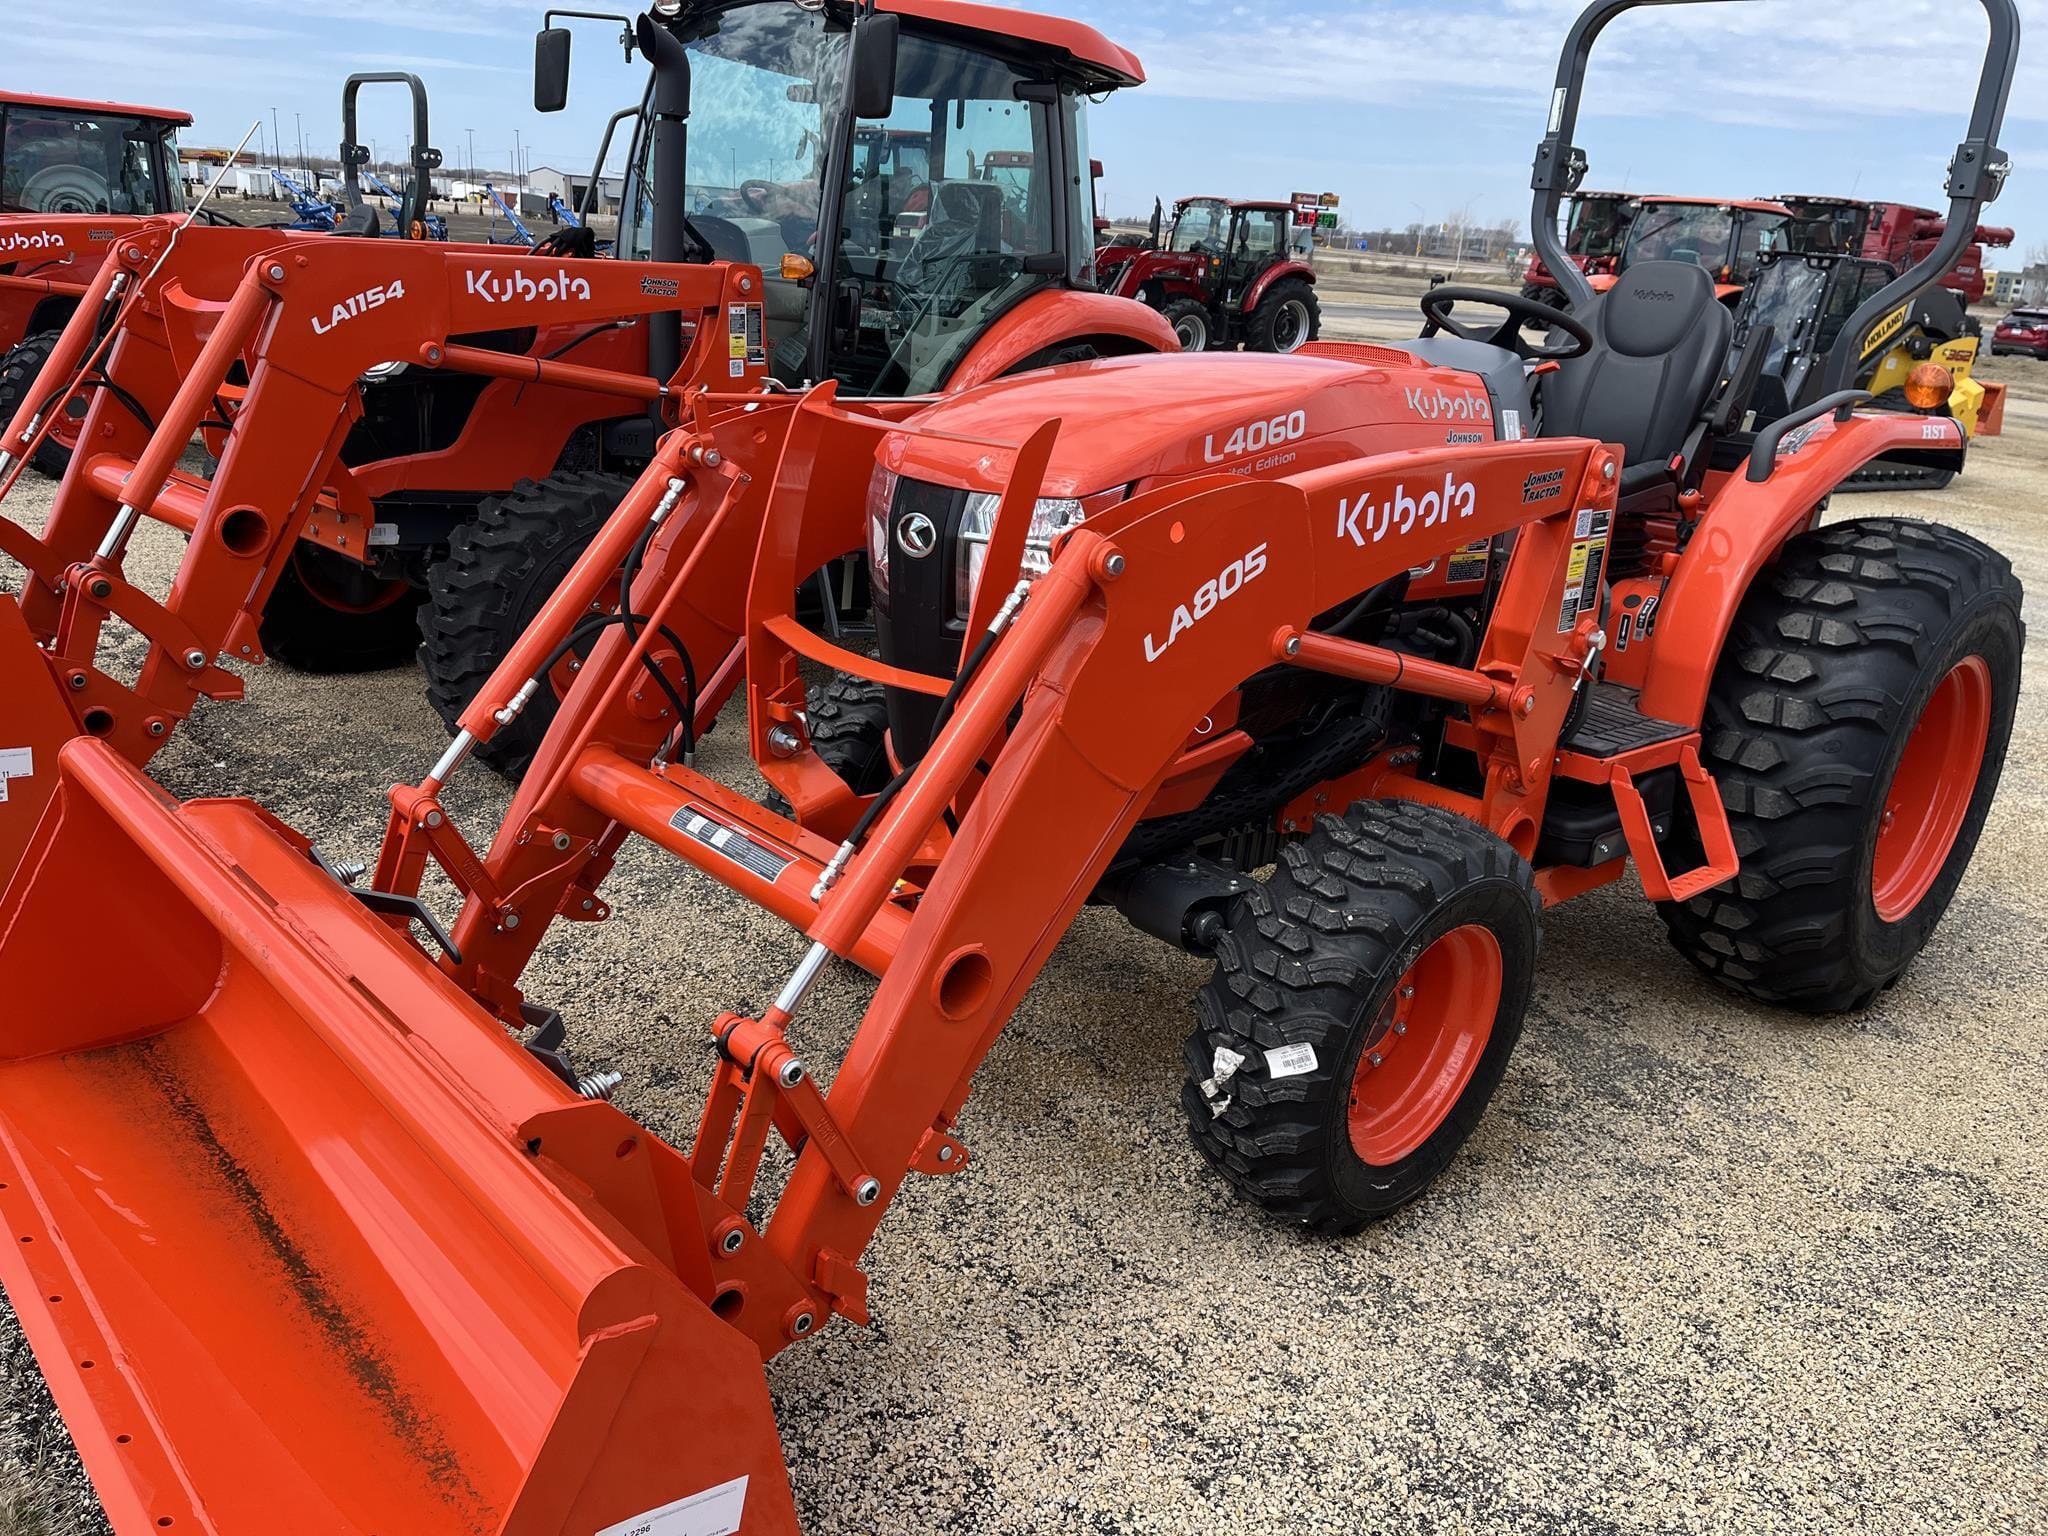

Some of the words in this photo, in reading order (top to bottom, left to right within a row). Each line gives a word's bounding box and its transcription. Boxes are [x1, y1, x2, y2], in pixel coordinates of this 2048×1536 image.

[0, 231, 64, 250] ubota
[466, 269, 590, 302] Kubota
[640, 276, 678, 288] JOHNSON
[641, 285, 678, 297] TRACTOR
[311, 279, 405, 335] LA1154
[1867, 312, 1903, 347] HOLLAND
[1405, 387, 1490, 419] Kubota
[1204, 410, 1305, 463] L4060
[1446, 429, 1483, 444] JOHNSON
[1922, 425, 1947, 440] HST
[1256, 452, 1296, 470] Edition
[1524, 468, 1564, 488] JOHNSON
[1522, 485, 1561, 503] TRACTOR
[1337, 472, 1475, 546] Kubota
[1143, 542, 1268, 663] LA805
[624, 1524, 651, 1536] 2296
